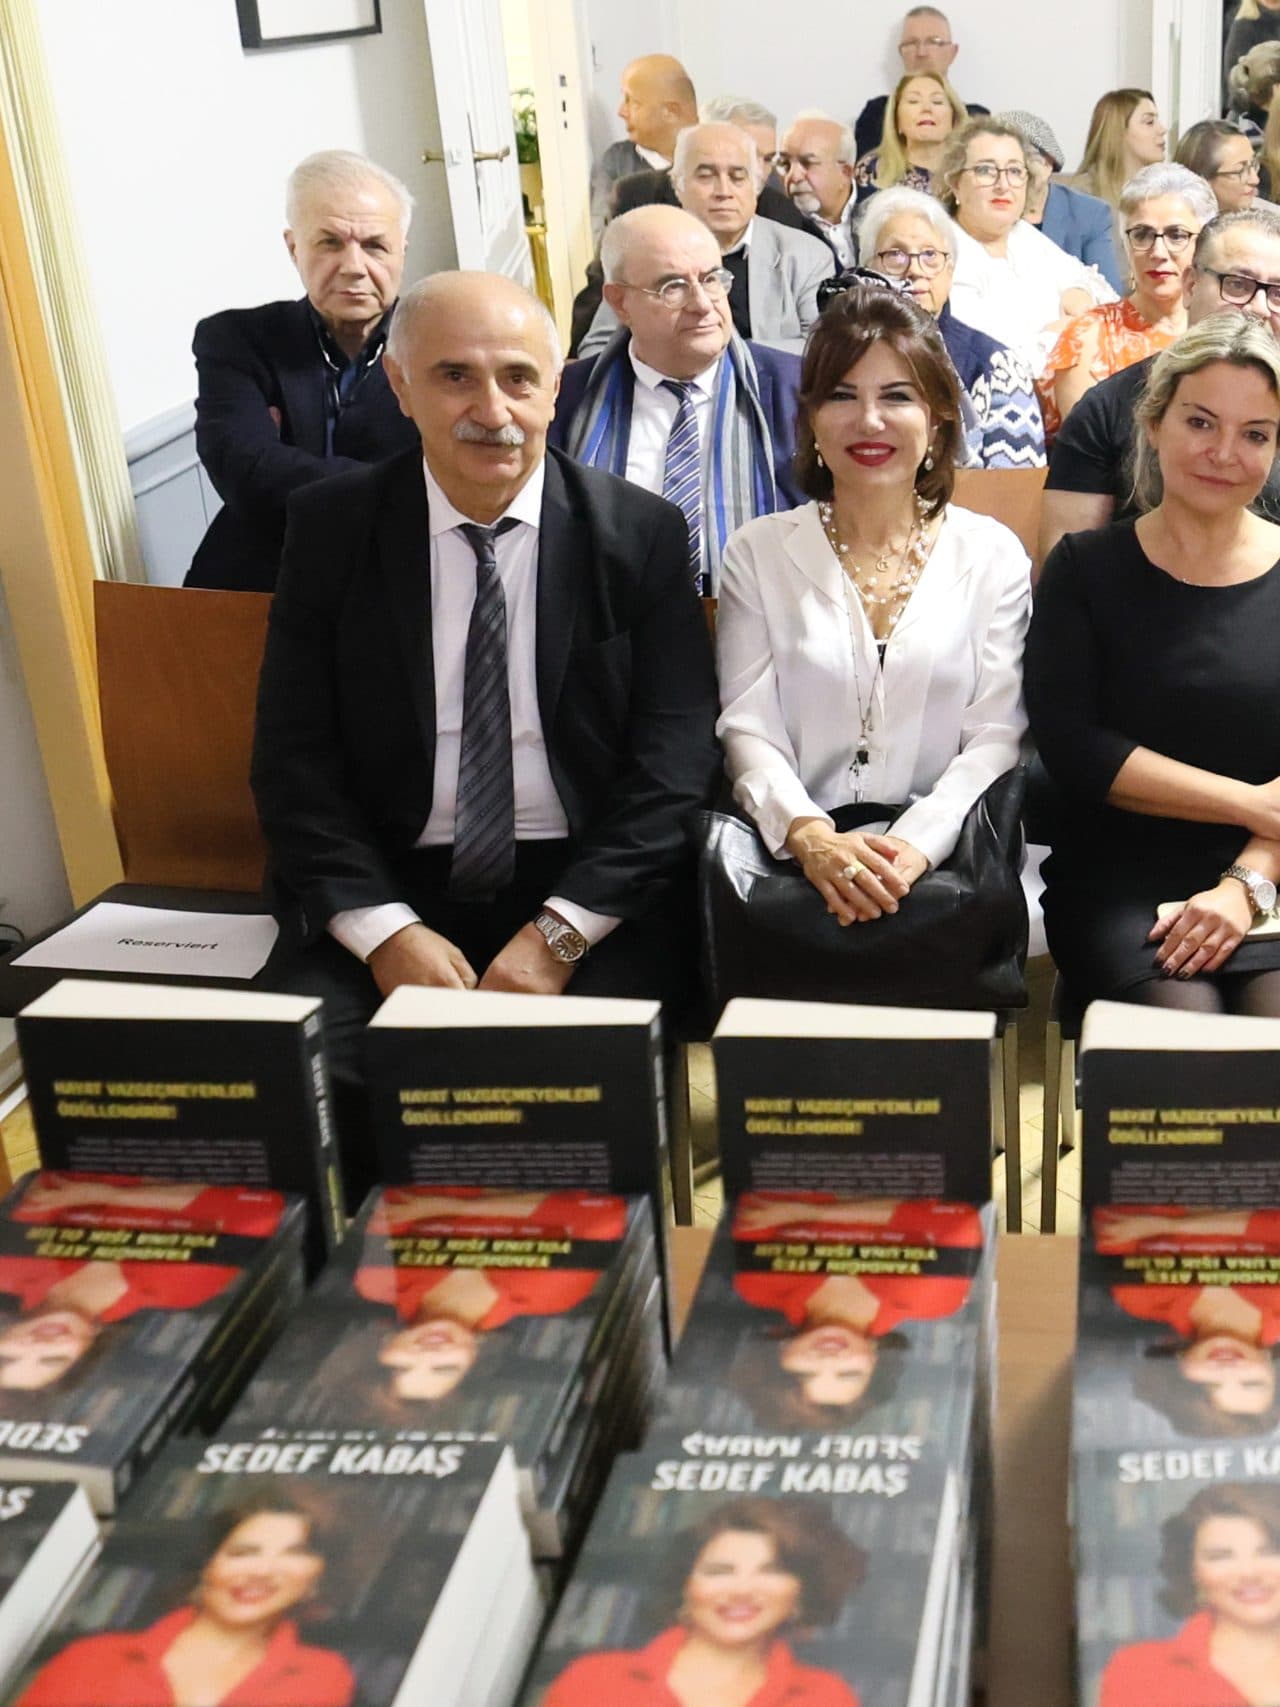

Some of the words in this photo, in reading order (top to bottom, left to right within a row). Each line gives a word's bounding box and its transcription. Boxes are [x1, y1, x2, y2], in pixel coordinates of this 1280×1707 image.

[117, 938, 219, 950] Reserviert
[196, 1443, 328, 1474] SEDEF
[329, 1444, 466, 1478] KABAŞ
[651, 1458, 777, 1492] SEDEF
[779, 1461, 910, 1497] KABAŞ
[1117, 1447, 1236, 1484] SEDEF
